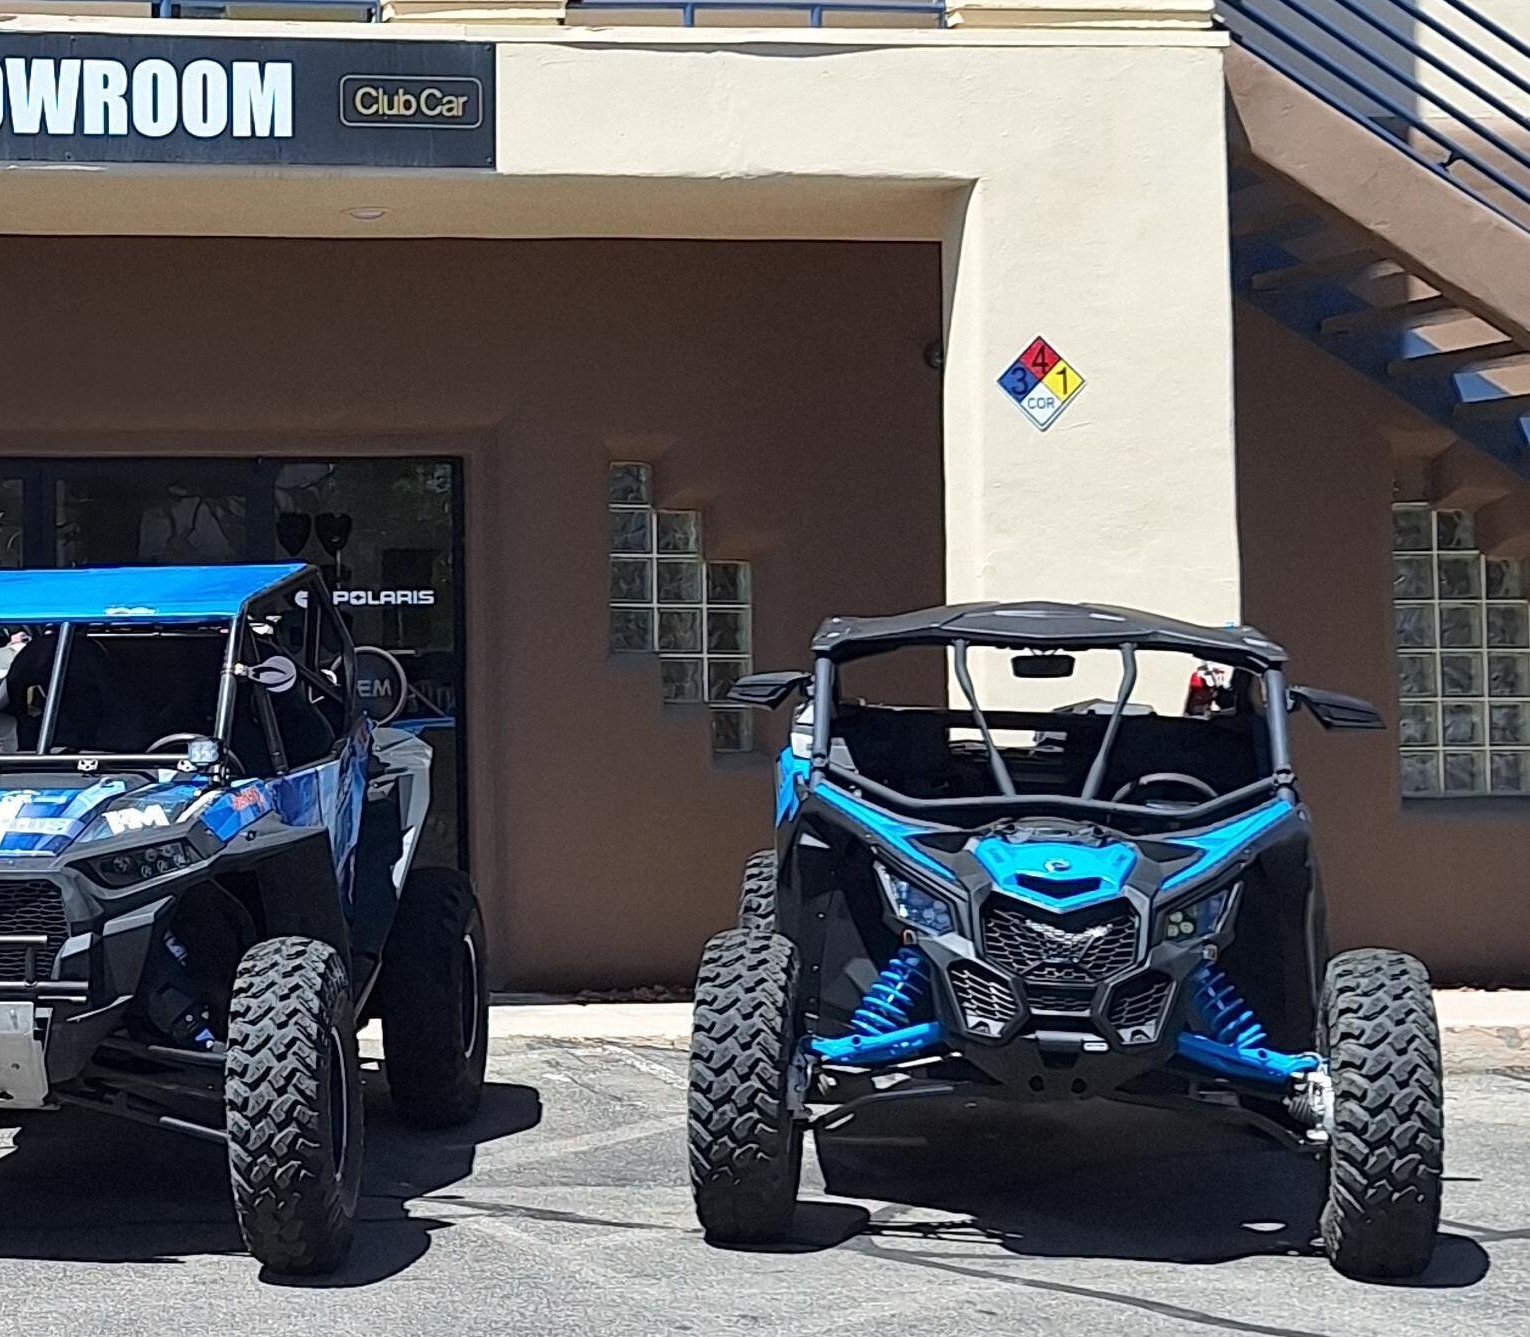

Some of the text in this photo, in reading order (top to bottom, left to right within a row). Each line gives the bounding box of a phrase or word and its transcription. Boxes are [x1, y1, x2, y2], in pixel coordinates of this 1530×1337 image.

[355, 86, 468, 118] Club Car
[1032, 345, 1050, 374] 4
[1011, 367, 1068, 396] 3 1
[1027, 397, 1055, 409] COR
[333, 590, 434, 605] POLARIS
[357, 679, 392, 698] EM
